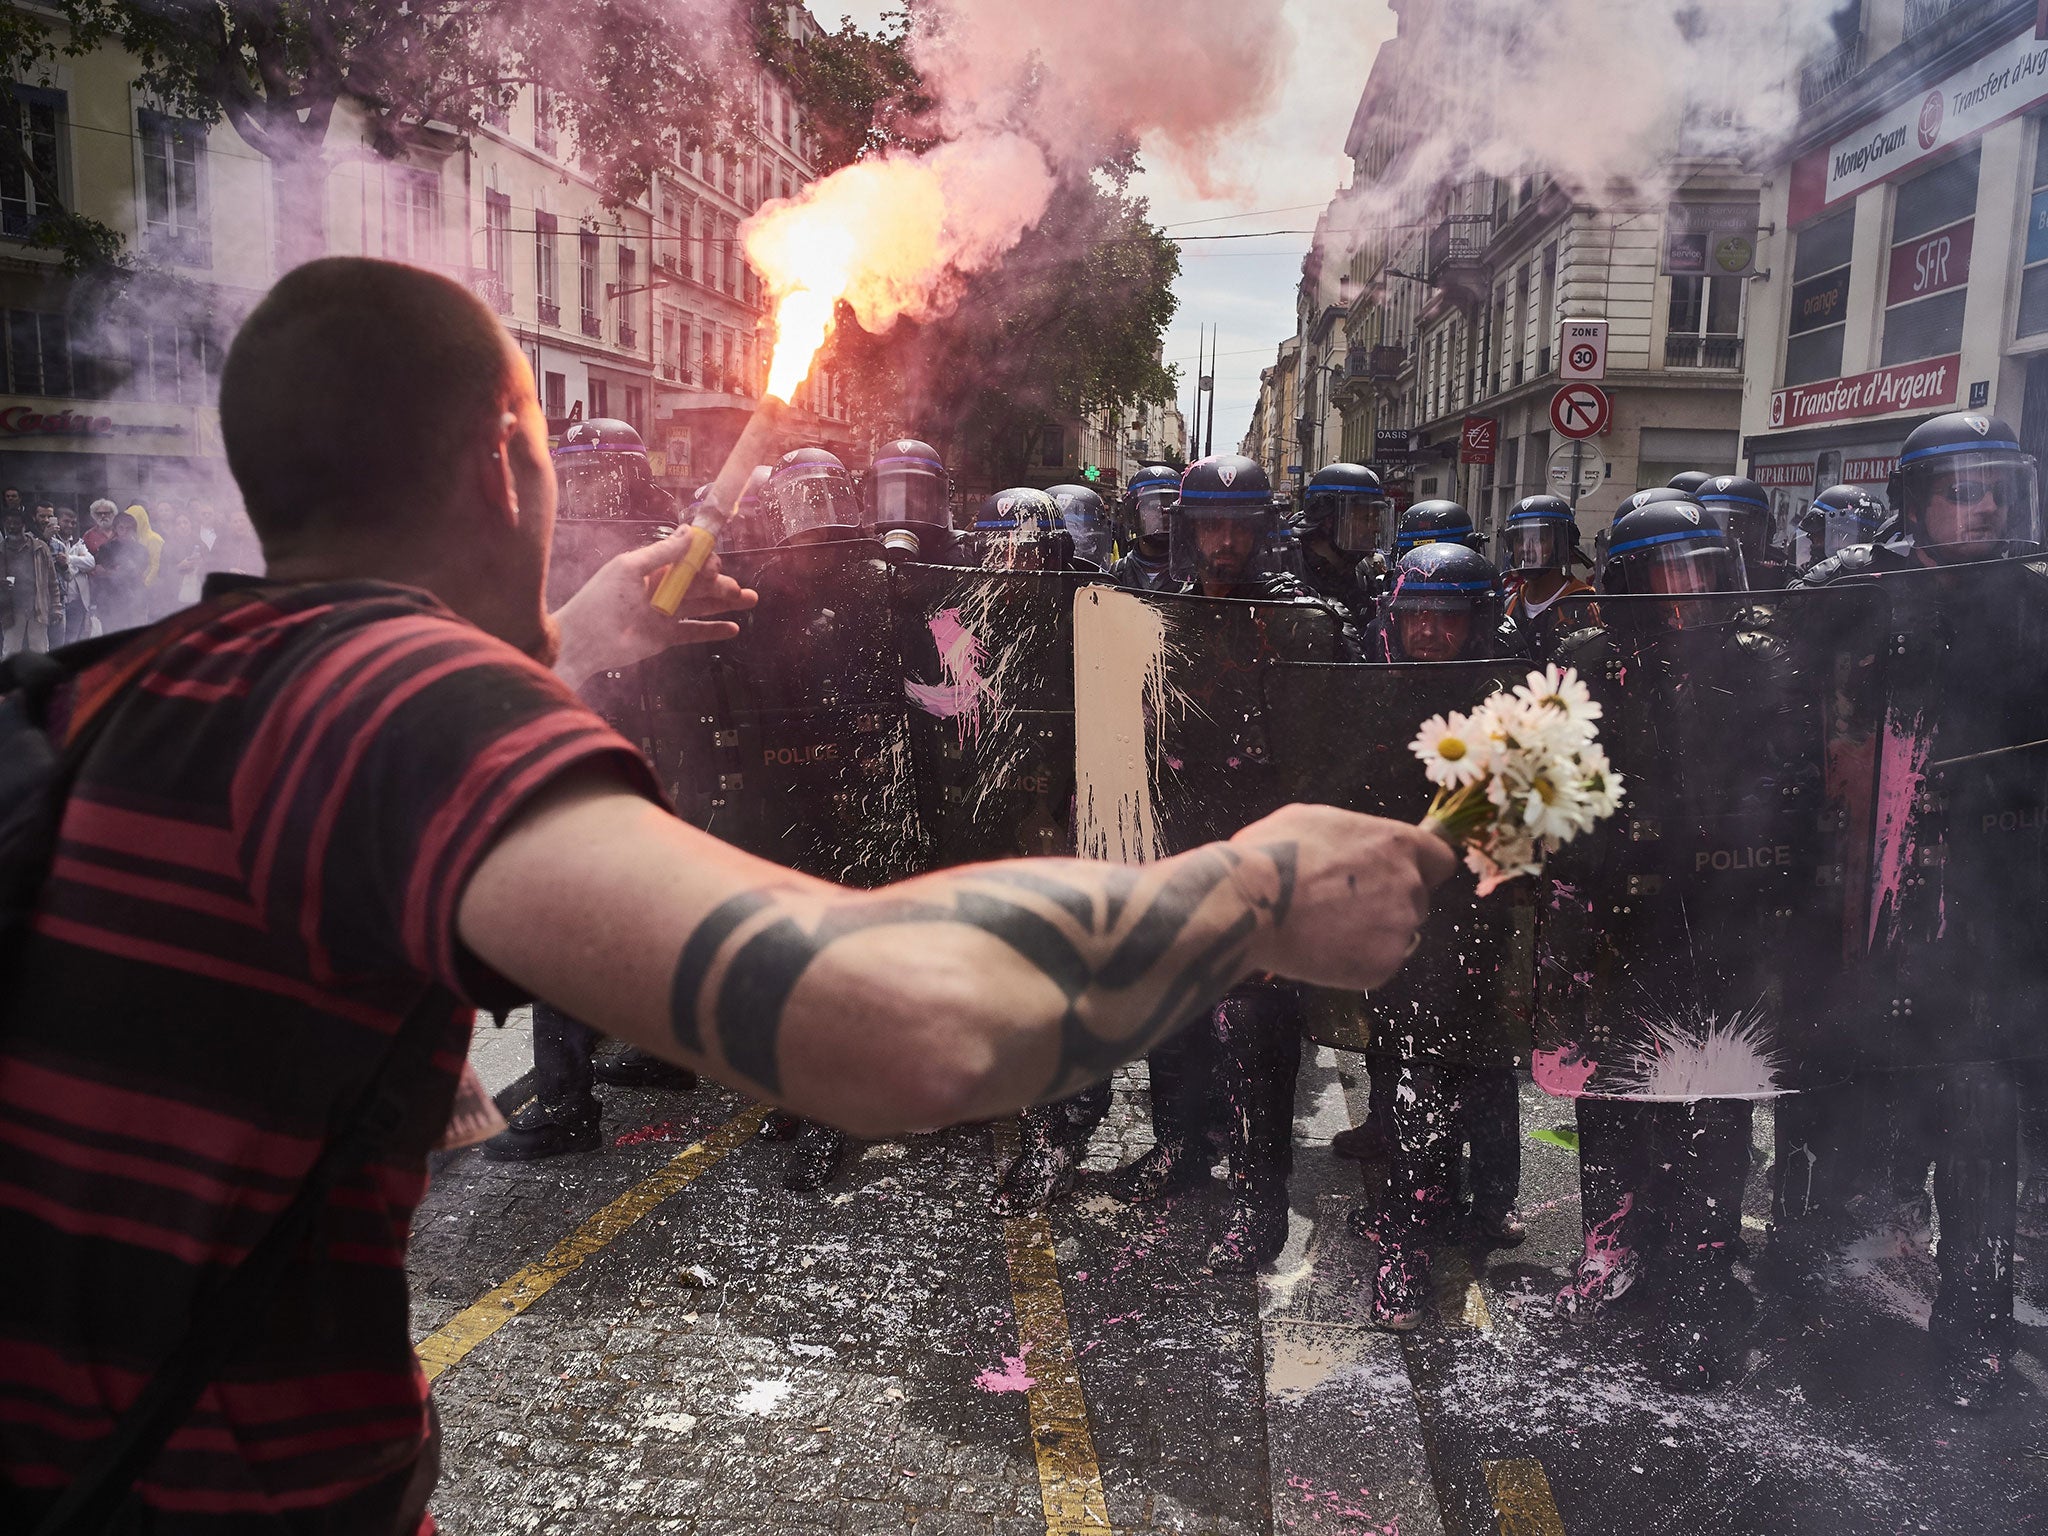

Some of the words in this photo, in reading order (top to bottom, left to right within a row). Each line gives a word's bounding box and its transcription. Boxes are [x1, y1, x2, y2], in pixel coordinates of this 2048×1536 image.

[1952, 68, 2011, 117] Transfert
[1832, 124, 1907, 181] MoneyGram
[1913, 236, 1950, 291] SFR
[1804, 288, 1839, 316] orange
[1572, 328, 1598, 337] ZONE
[1574, 351, 1592, 364] 30
[1792, 377, 1861, 418] Transfert
[1862, 365, 1946, 408] d'Argent
[1377, 431, 1408, 440] OASIS
[763, 743, 839, 766] POLICE
[1694, 845, 1791, 872] POLICE
